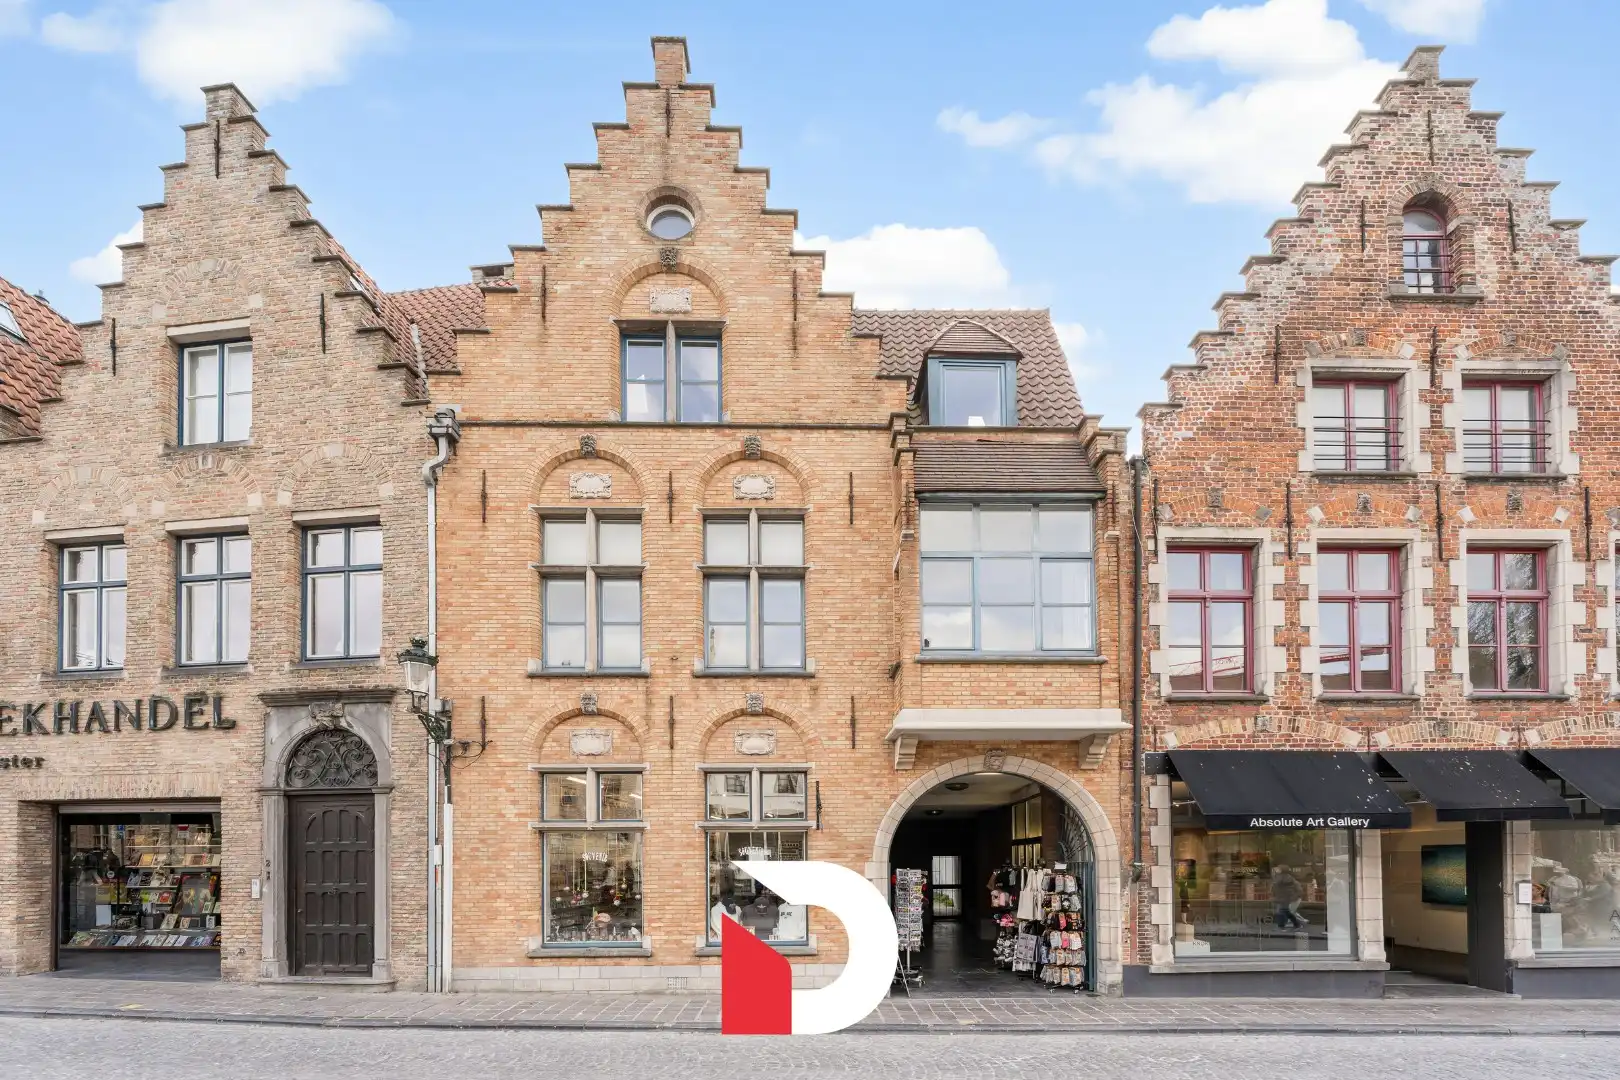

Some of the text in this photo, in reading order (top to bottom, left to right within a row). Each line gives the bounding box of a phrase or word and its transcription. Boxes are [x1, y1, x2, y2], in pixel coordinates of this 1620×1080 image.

[0, 691, 237, 736] EKHANDEL
[1250, 817, 1370, 828] Absolute Art Gallery
